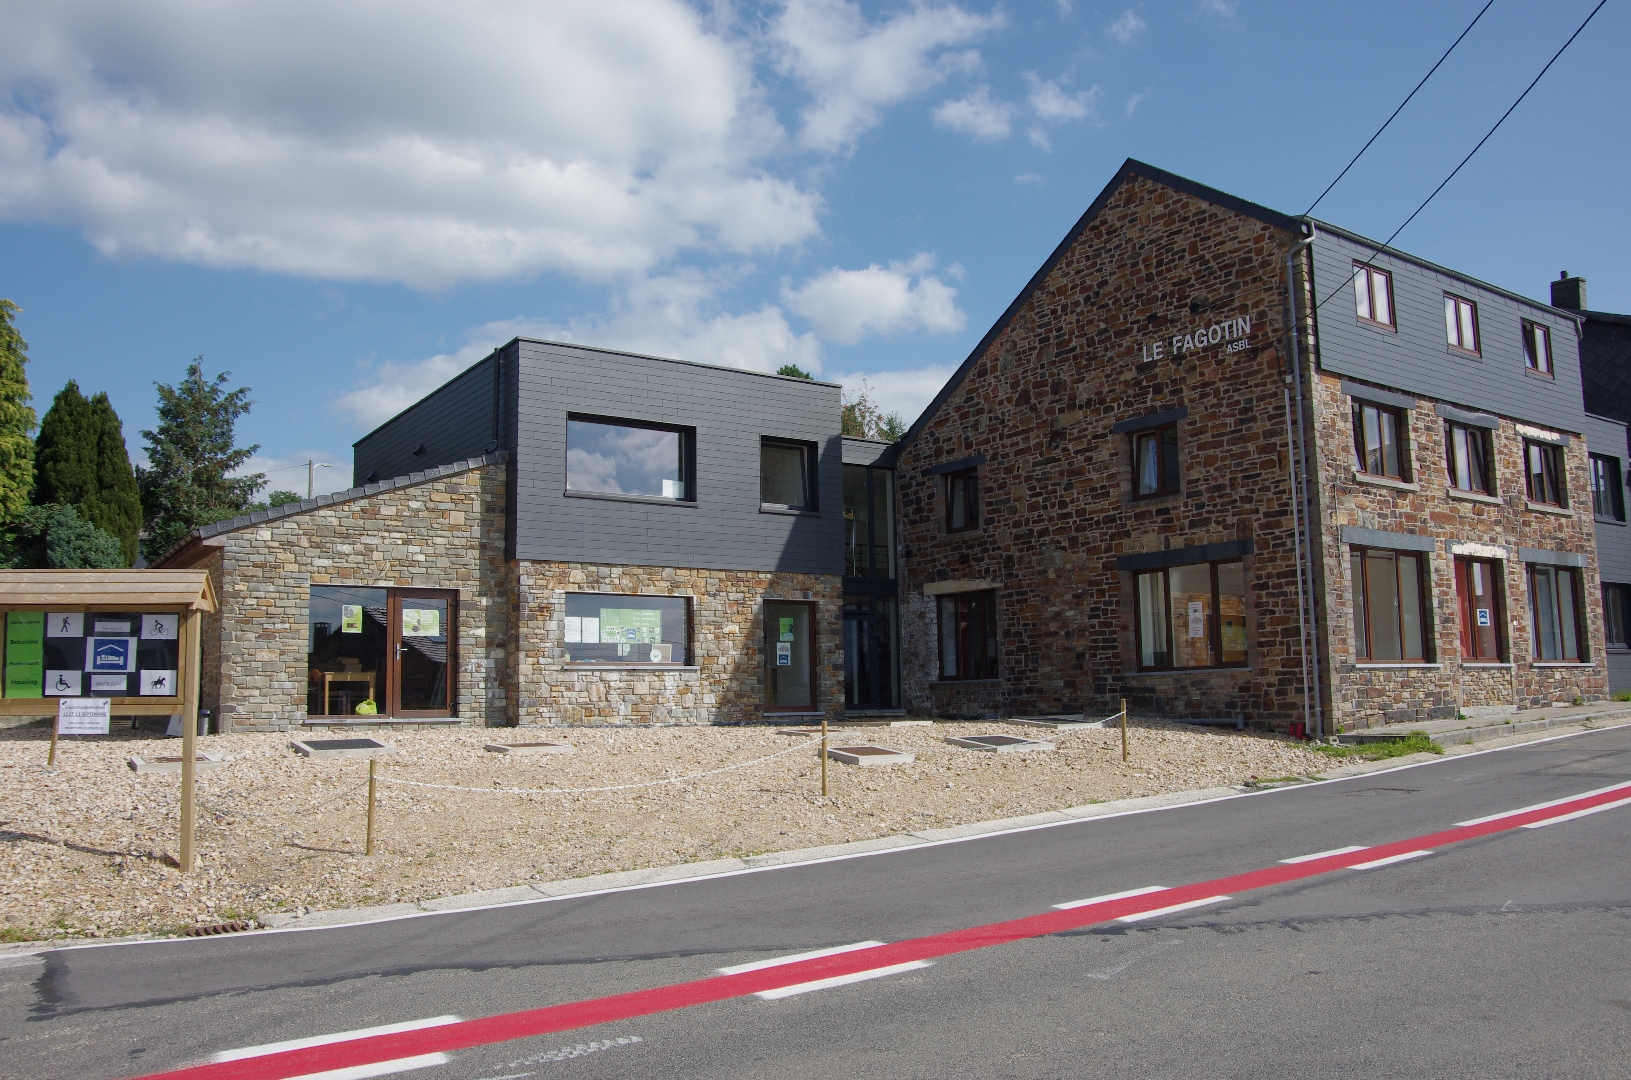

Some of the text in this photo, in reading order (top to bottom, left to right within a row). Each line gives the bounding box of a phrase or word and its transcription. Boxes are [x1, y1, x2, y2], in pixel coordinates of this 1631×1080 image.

[1143, 315, 1251, 362] LE FAGOTIN
[1226, 338, 1252, 355] ASBL
